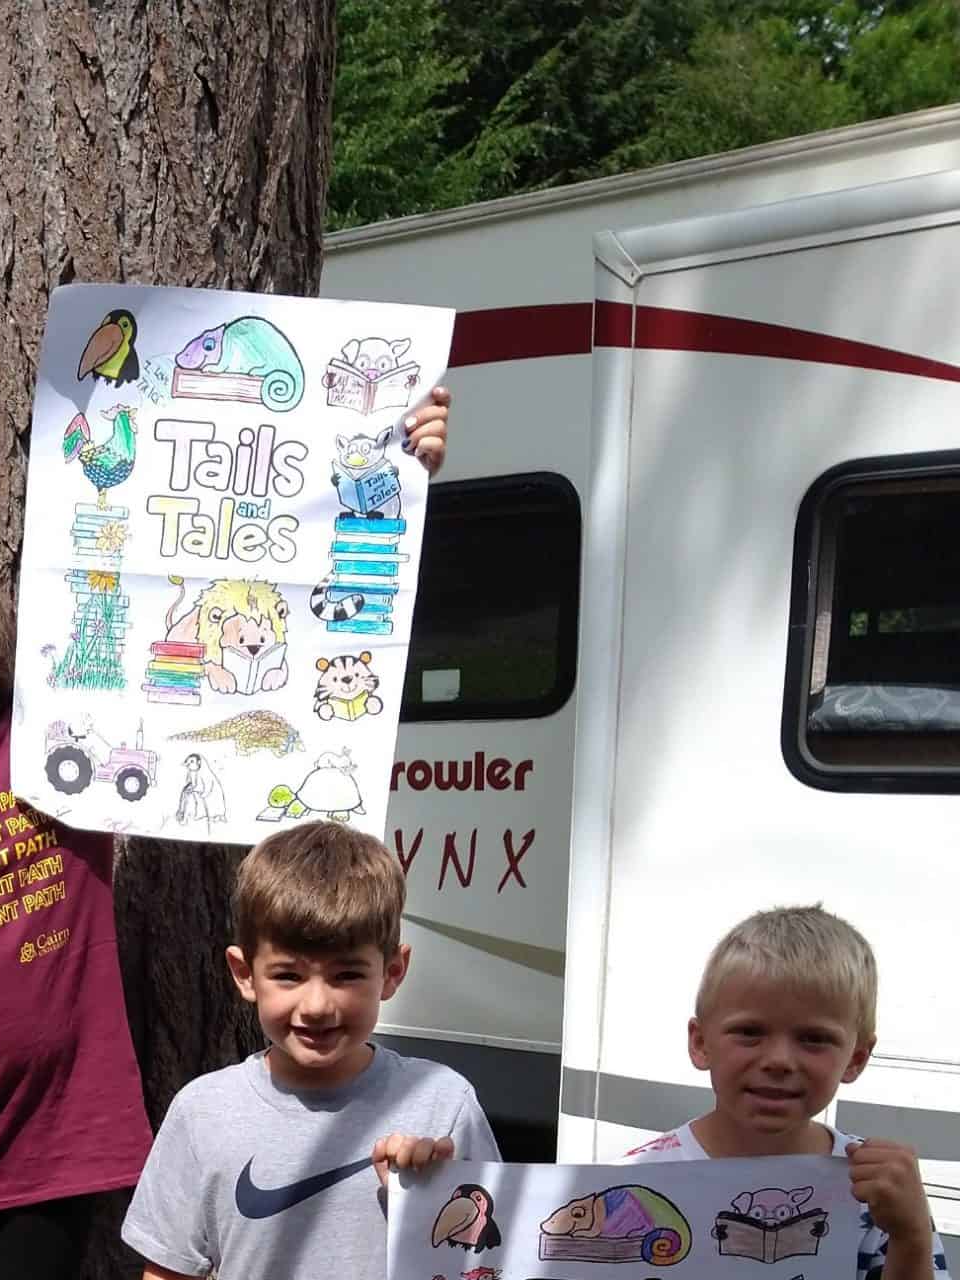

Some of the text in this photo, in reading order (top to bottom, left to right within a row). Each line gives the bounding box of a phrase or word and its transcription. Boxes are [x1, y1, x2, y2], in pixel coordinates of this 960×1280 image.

[153, 418, 309, 498] Tails
[235, 497, 272, 519] and
[368, 483, 398, 505] Tales
[146, 495, 304, 564] Tales
[390, 752, 534, 791] rowler
[15, 829, 58, 859] PATH
[395, 828, 536, 894] YNX
[18, 854, 65, 888] PATH
[22, 881, 66, 914] PATH
